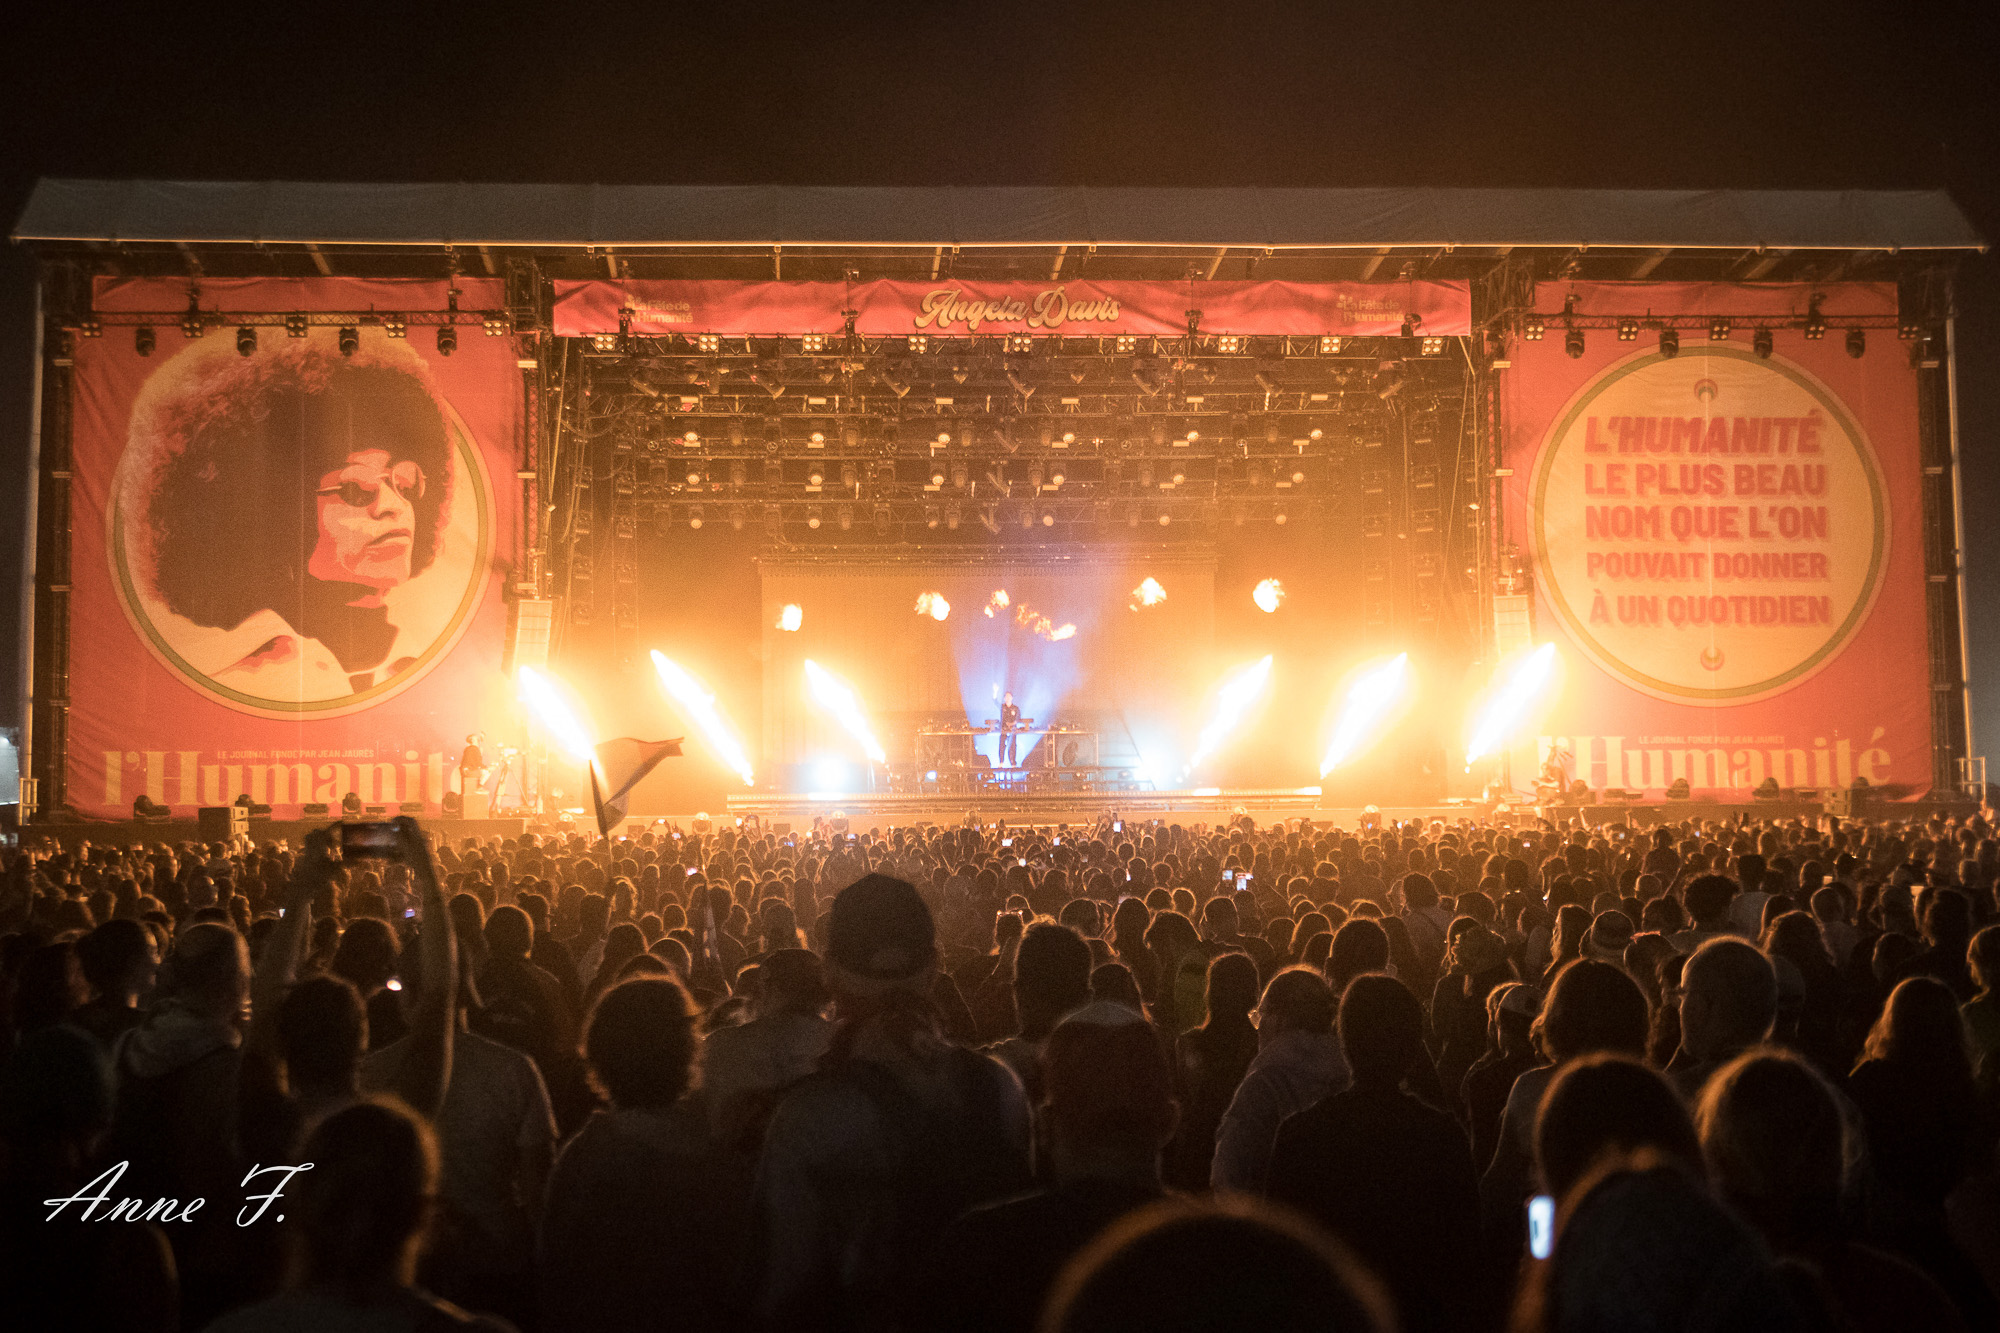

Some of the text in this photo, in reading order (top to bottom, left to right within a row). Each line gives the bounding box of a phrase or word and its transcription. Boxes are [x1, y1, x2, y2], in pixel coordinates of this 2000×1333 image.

[914, 286, 1121, 331] Angela Davis
[1584, 408, 1825, 455] L'HUMANITÉ
[1584, 463, 1828, 496] LE PLUS BEAU
[1585, 505, 1828, 542] NOM QUE L'ON
[1586, 552, 1828, 579] POUVAIT DONNER
[1589, 588, 1831, 627] À UN QUOTIDIEN
[217, 750, 227, 759] LE
[229, 750, 269, 759] JOURNAL
[299, 749, 317, 759] PAR
[317, 749, 341, 759] JEAN
